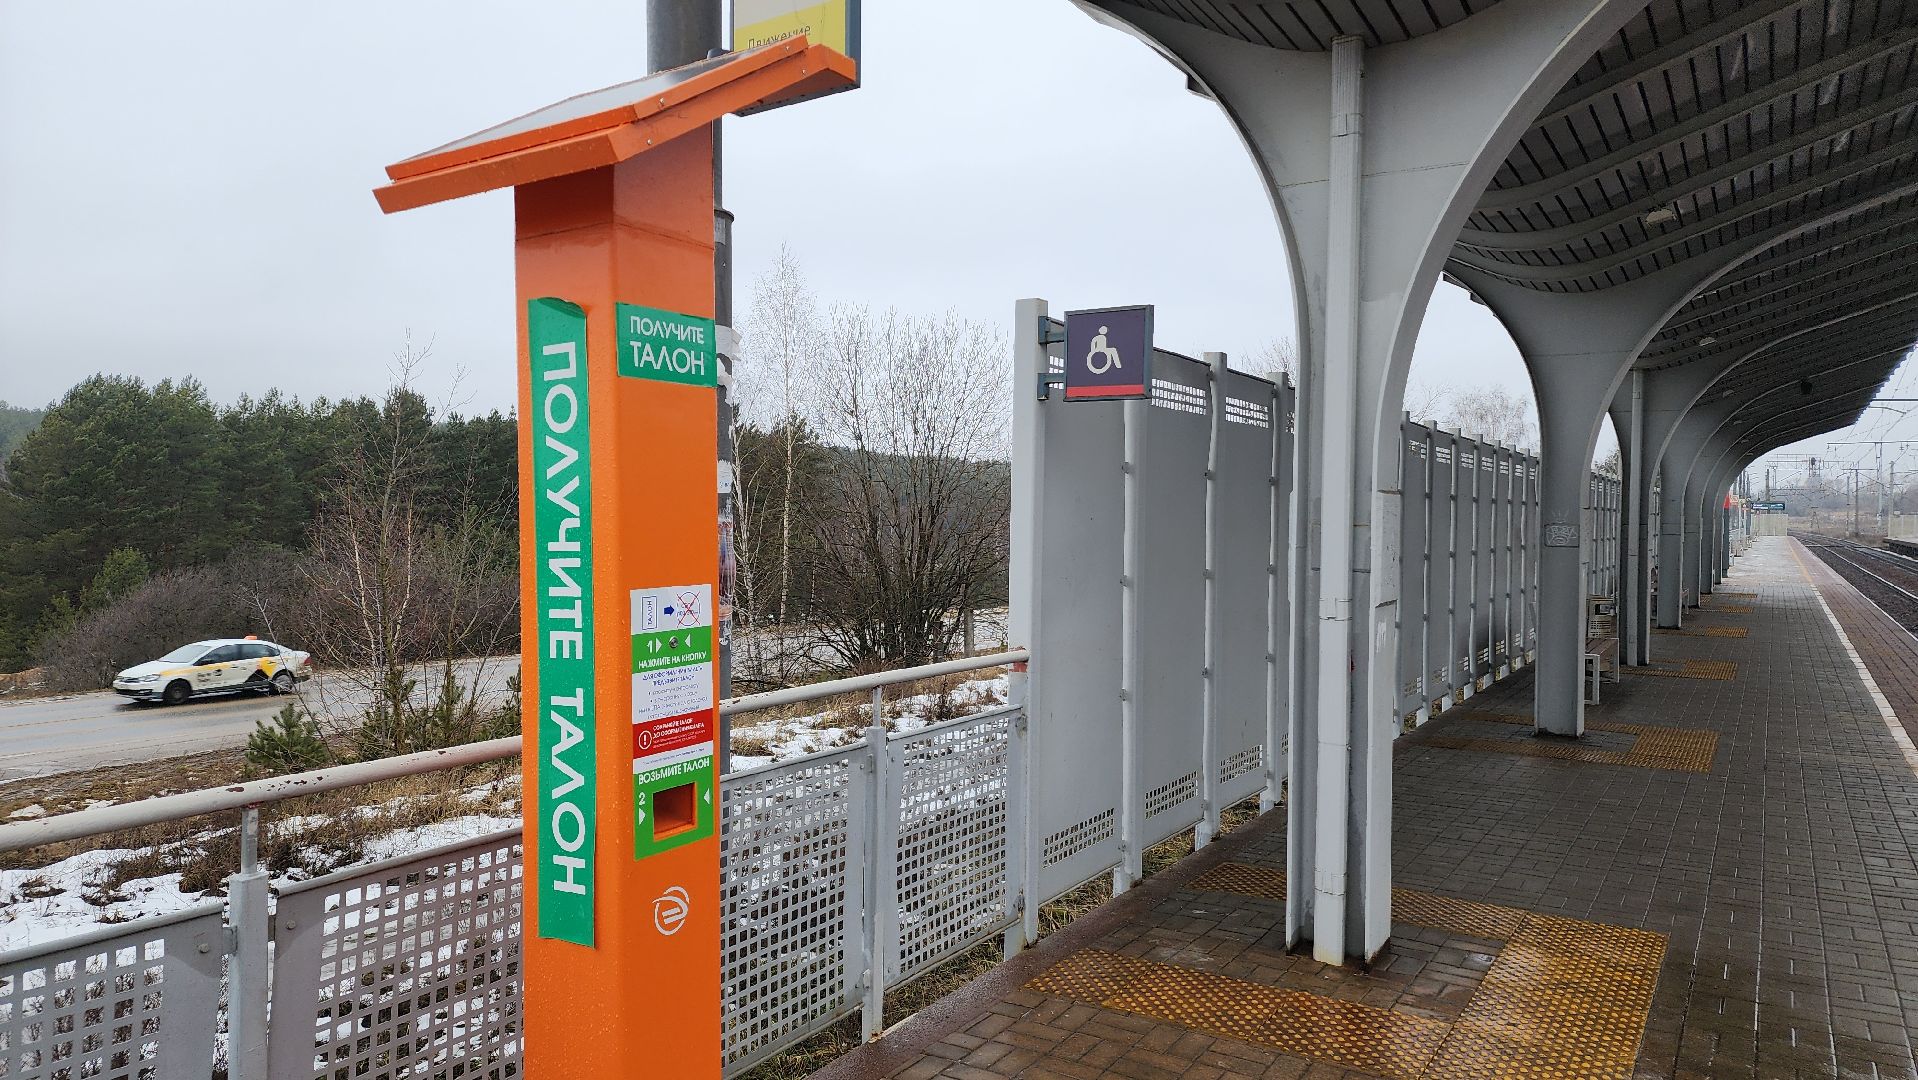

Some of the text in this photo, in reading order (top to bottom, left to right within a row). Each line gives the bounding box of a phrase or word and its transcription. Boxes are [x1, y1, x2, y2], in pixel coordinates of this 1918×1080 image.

[630, 315, 705, 344] ПОЛУЧИТЕ
[629, 340, 705, 376] ТАЛОН
[542, 341, 587, 896] ПОЛУЧИТЕ ТАЛОН
[638, 650, 707, 669] НАЖМИТЕ НА КНОПКУ
[646, 639, 653, 654] 1
[638, 757, 709, 786] ВОЗЬМИТЕ ТАЛОН
[638, 792, 646, 806] 2
